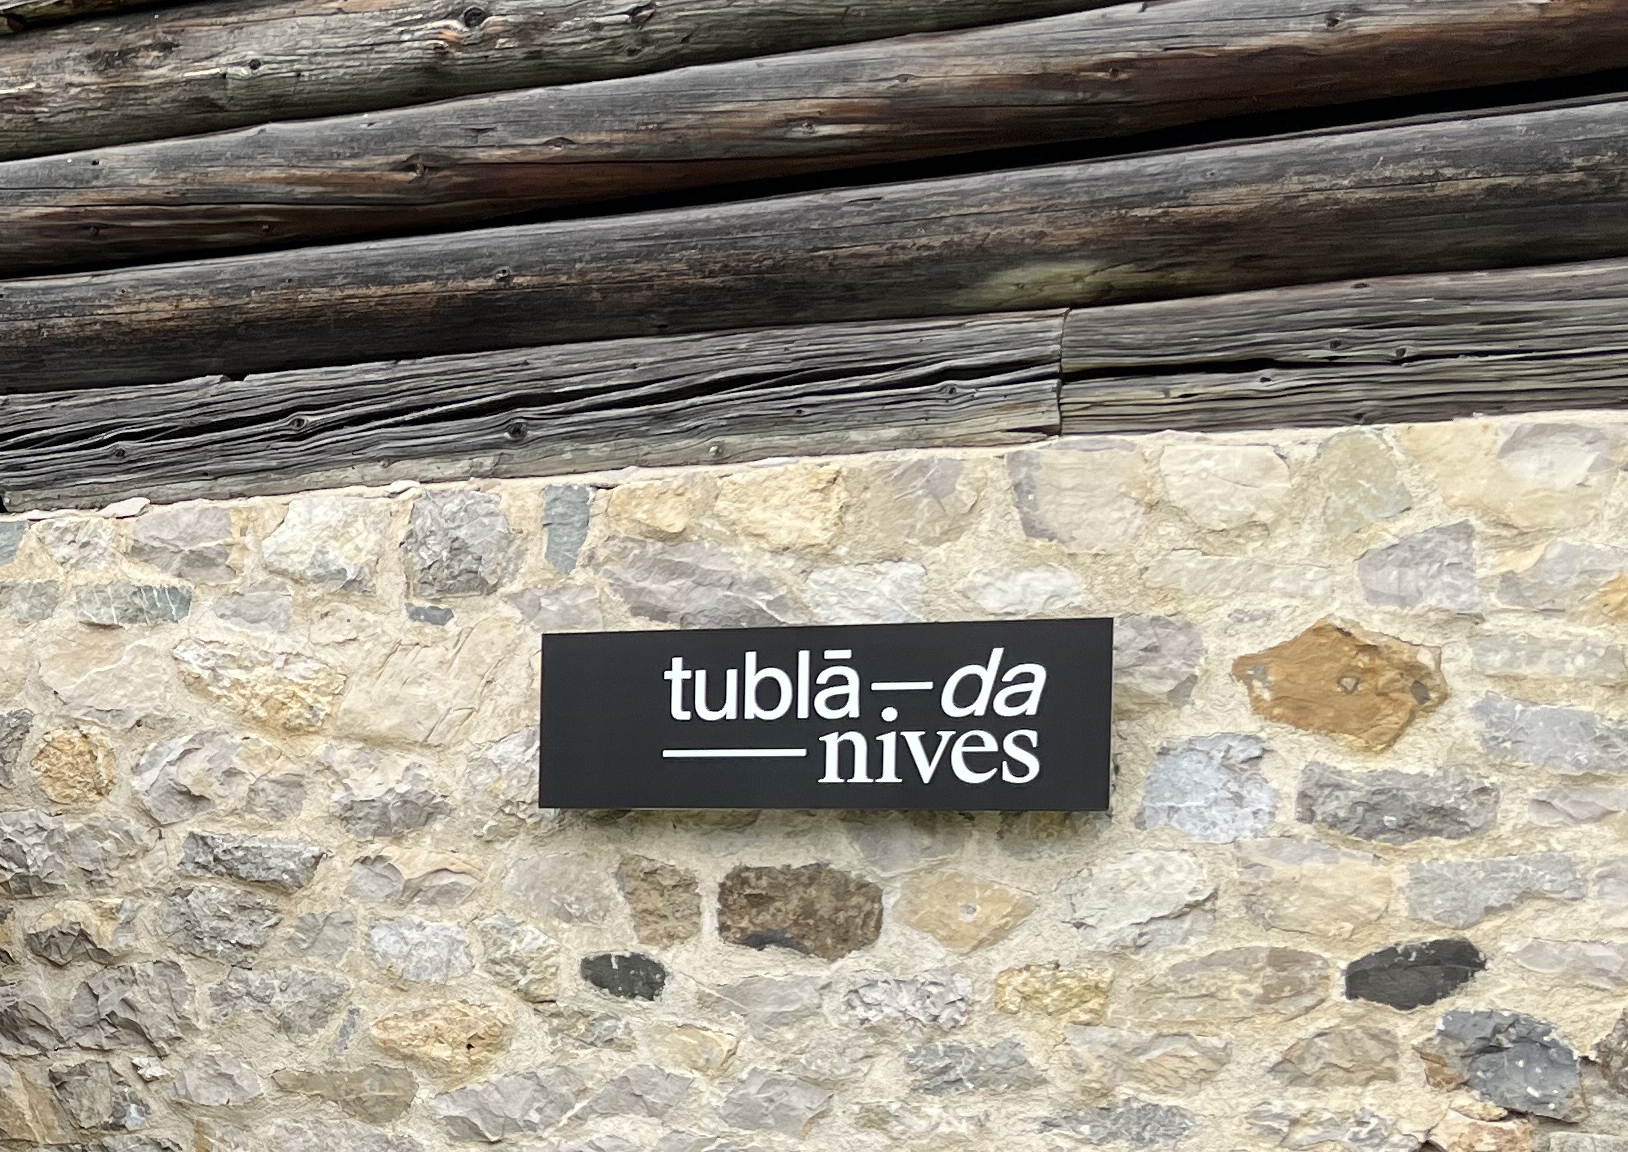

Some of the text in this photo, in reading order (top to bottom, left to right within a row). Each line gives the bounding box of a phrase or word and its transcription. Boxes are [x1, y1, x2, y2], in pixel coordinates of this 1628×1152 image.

[663, 647, 1048, 721] tublā da
[818, 706, 1041, 784] nives
